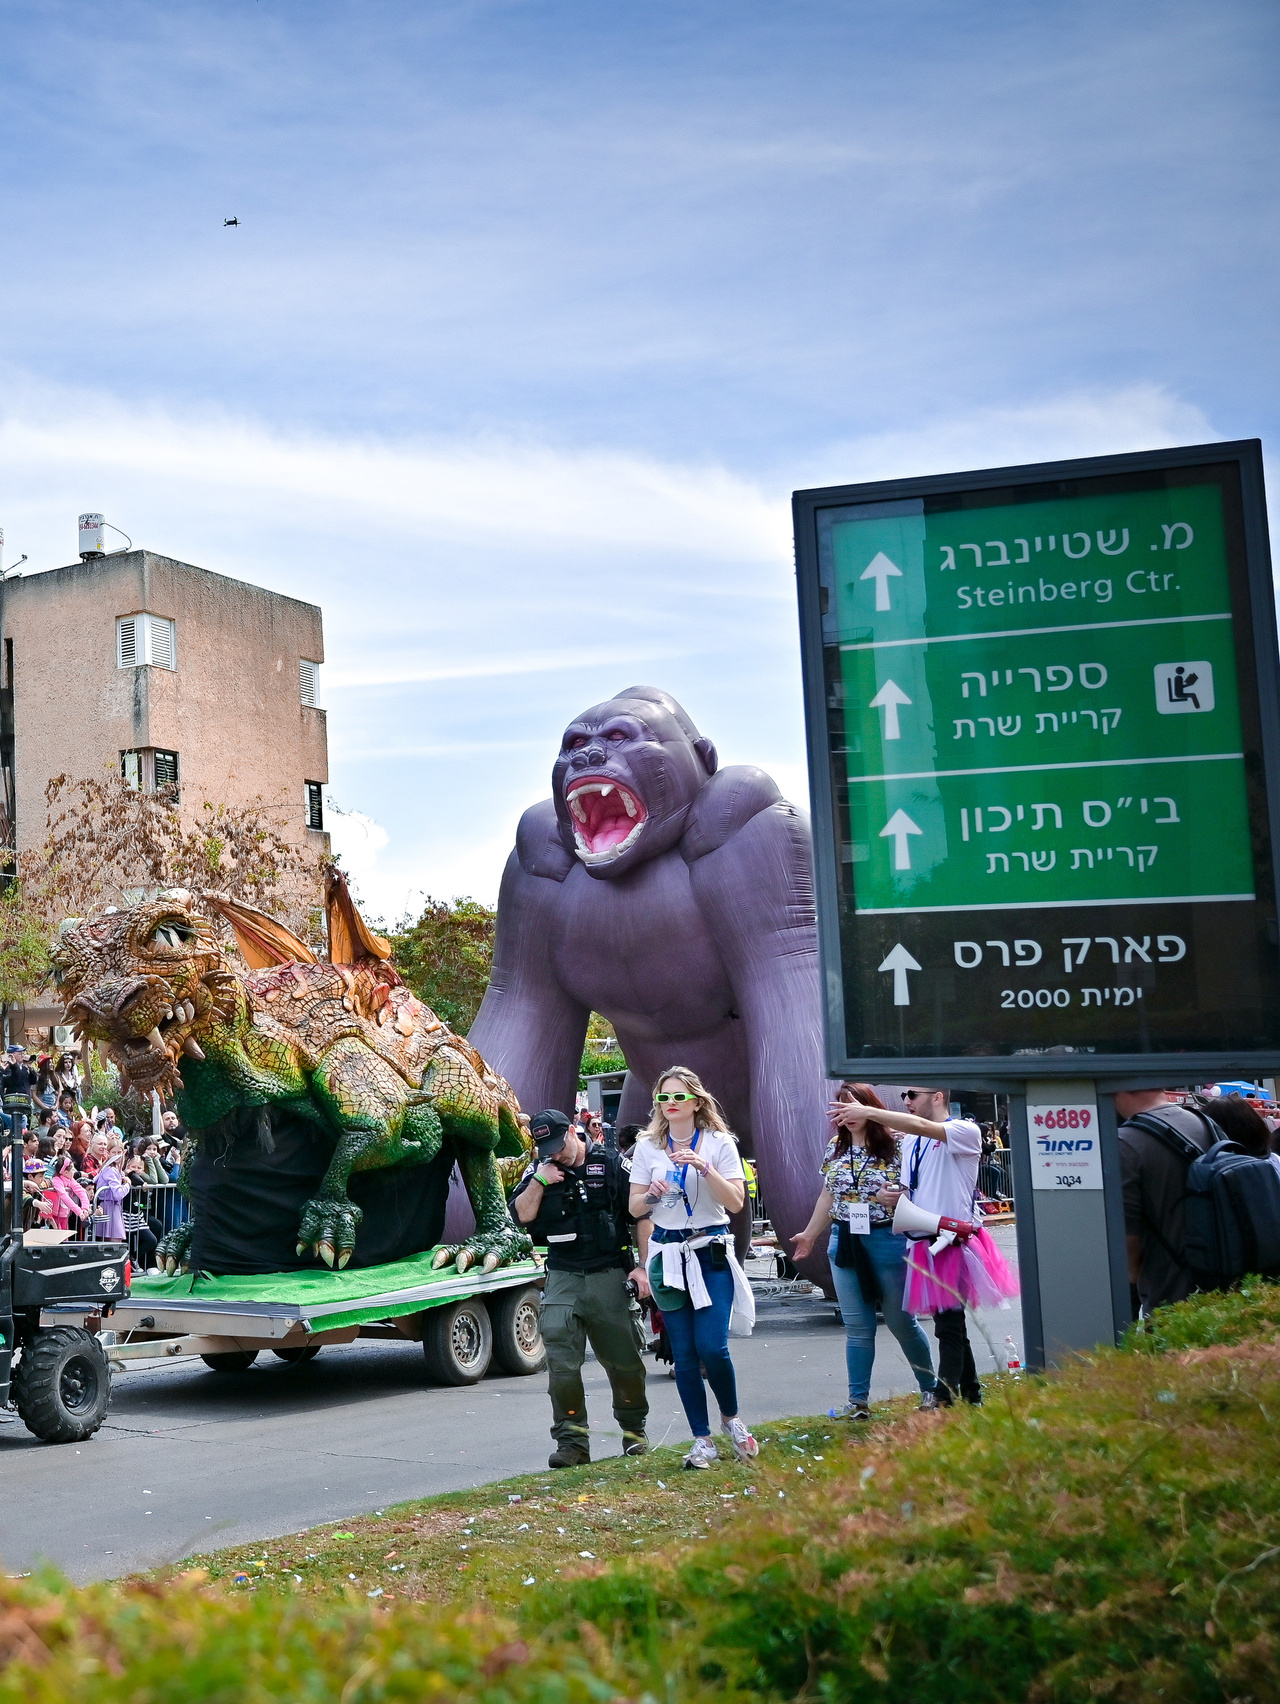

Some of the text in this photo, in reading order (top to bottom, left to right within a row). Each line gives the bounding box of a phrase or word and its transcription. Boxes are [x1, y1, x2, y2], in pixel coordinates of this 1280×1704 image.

[939, 522, 1194, 571] מ. שטיינברג
[957, 570, 1181, 609] Steinberg Ctr.
[961, 662, 1108, 698] ספרייה
[953, 708, 1122, 740] קריית שרת
[960, 803, 1062, 842] תיכון
[986, 845, 1158, 874] קריית שרת
[953, 935, 1187, 973] פארק פרס
[1000, 987, 1143, 1009] ימית 2000
[1037, 1140, 1093, 1152] מאור
